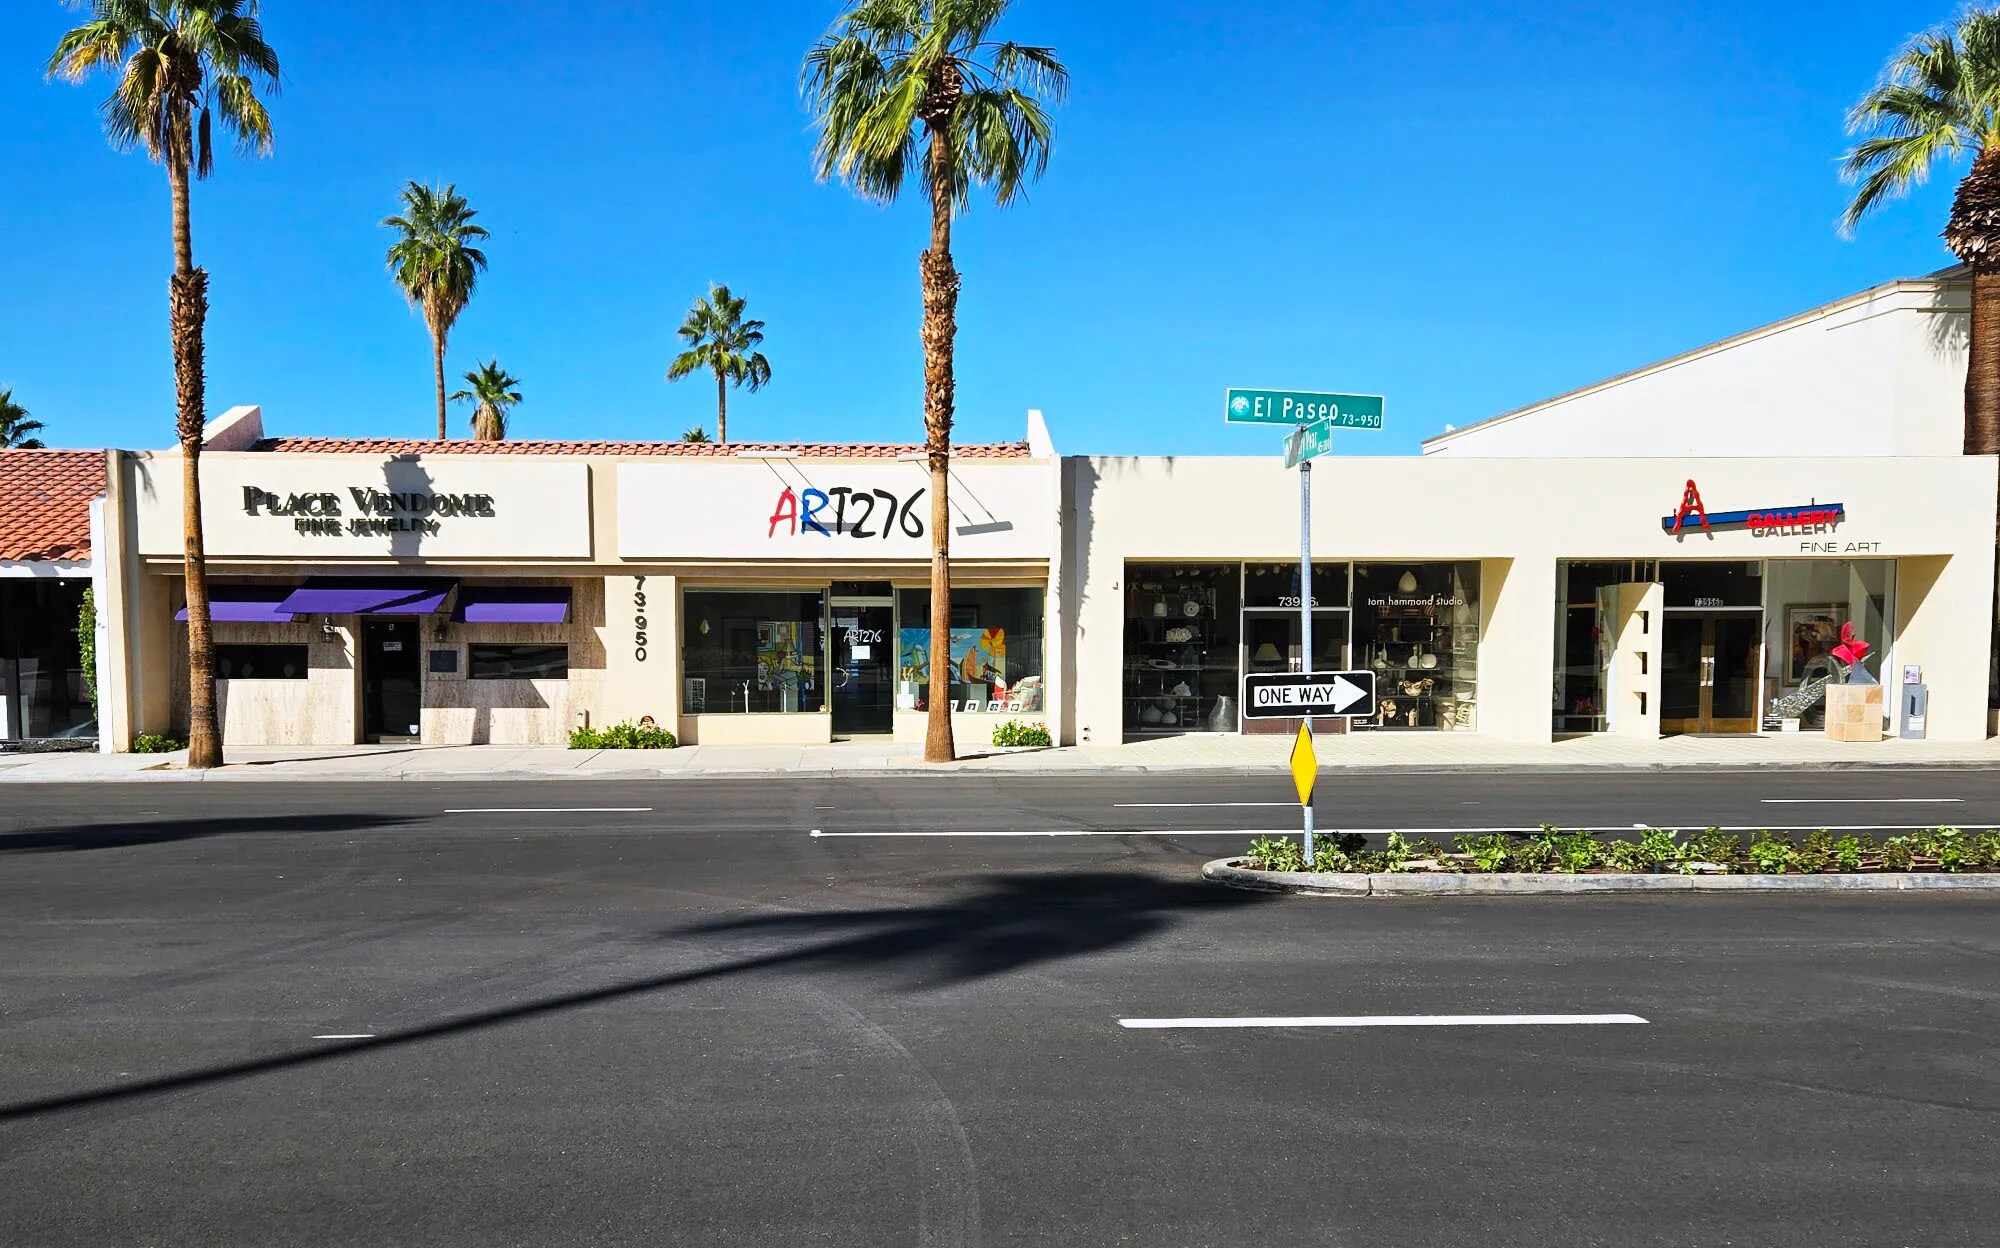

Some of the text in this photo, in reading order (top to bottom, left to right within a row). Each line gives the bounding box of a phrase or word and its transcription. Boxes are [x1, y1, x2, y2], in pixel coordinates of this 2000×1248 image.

[1253, 396, 1380, 427] El Paseo 73-950
[241, 486, 494, 514] PLACE VENDOME
[1672, 479, 1839, 533] A GALLERY
[768, 486, 926, 540] ART276
[294, 518, 438, 534] FINE JEWELRY
[1800, 542, 1882, 553] FINE ART
[1367, 593, 1463, 606] tom hammond studio
[633, 574, 648, 663] 73-950
[843, 629, 882, 643] ART276
[1259, 686, 1334, 704] ONE WAY
